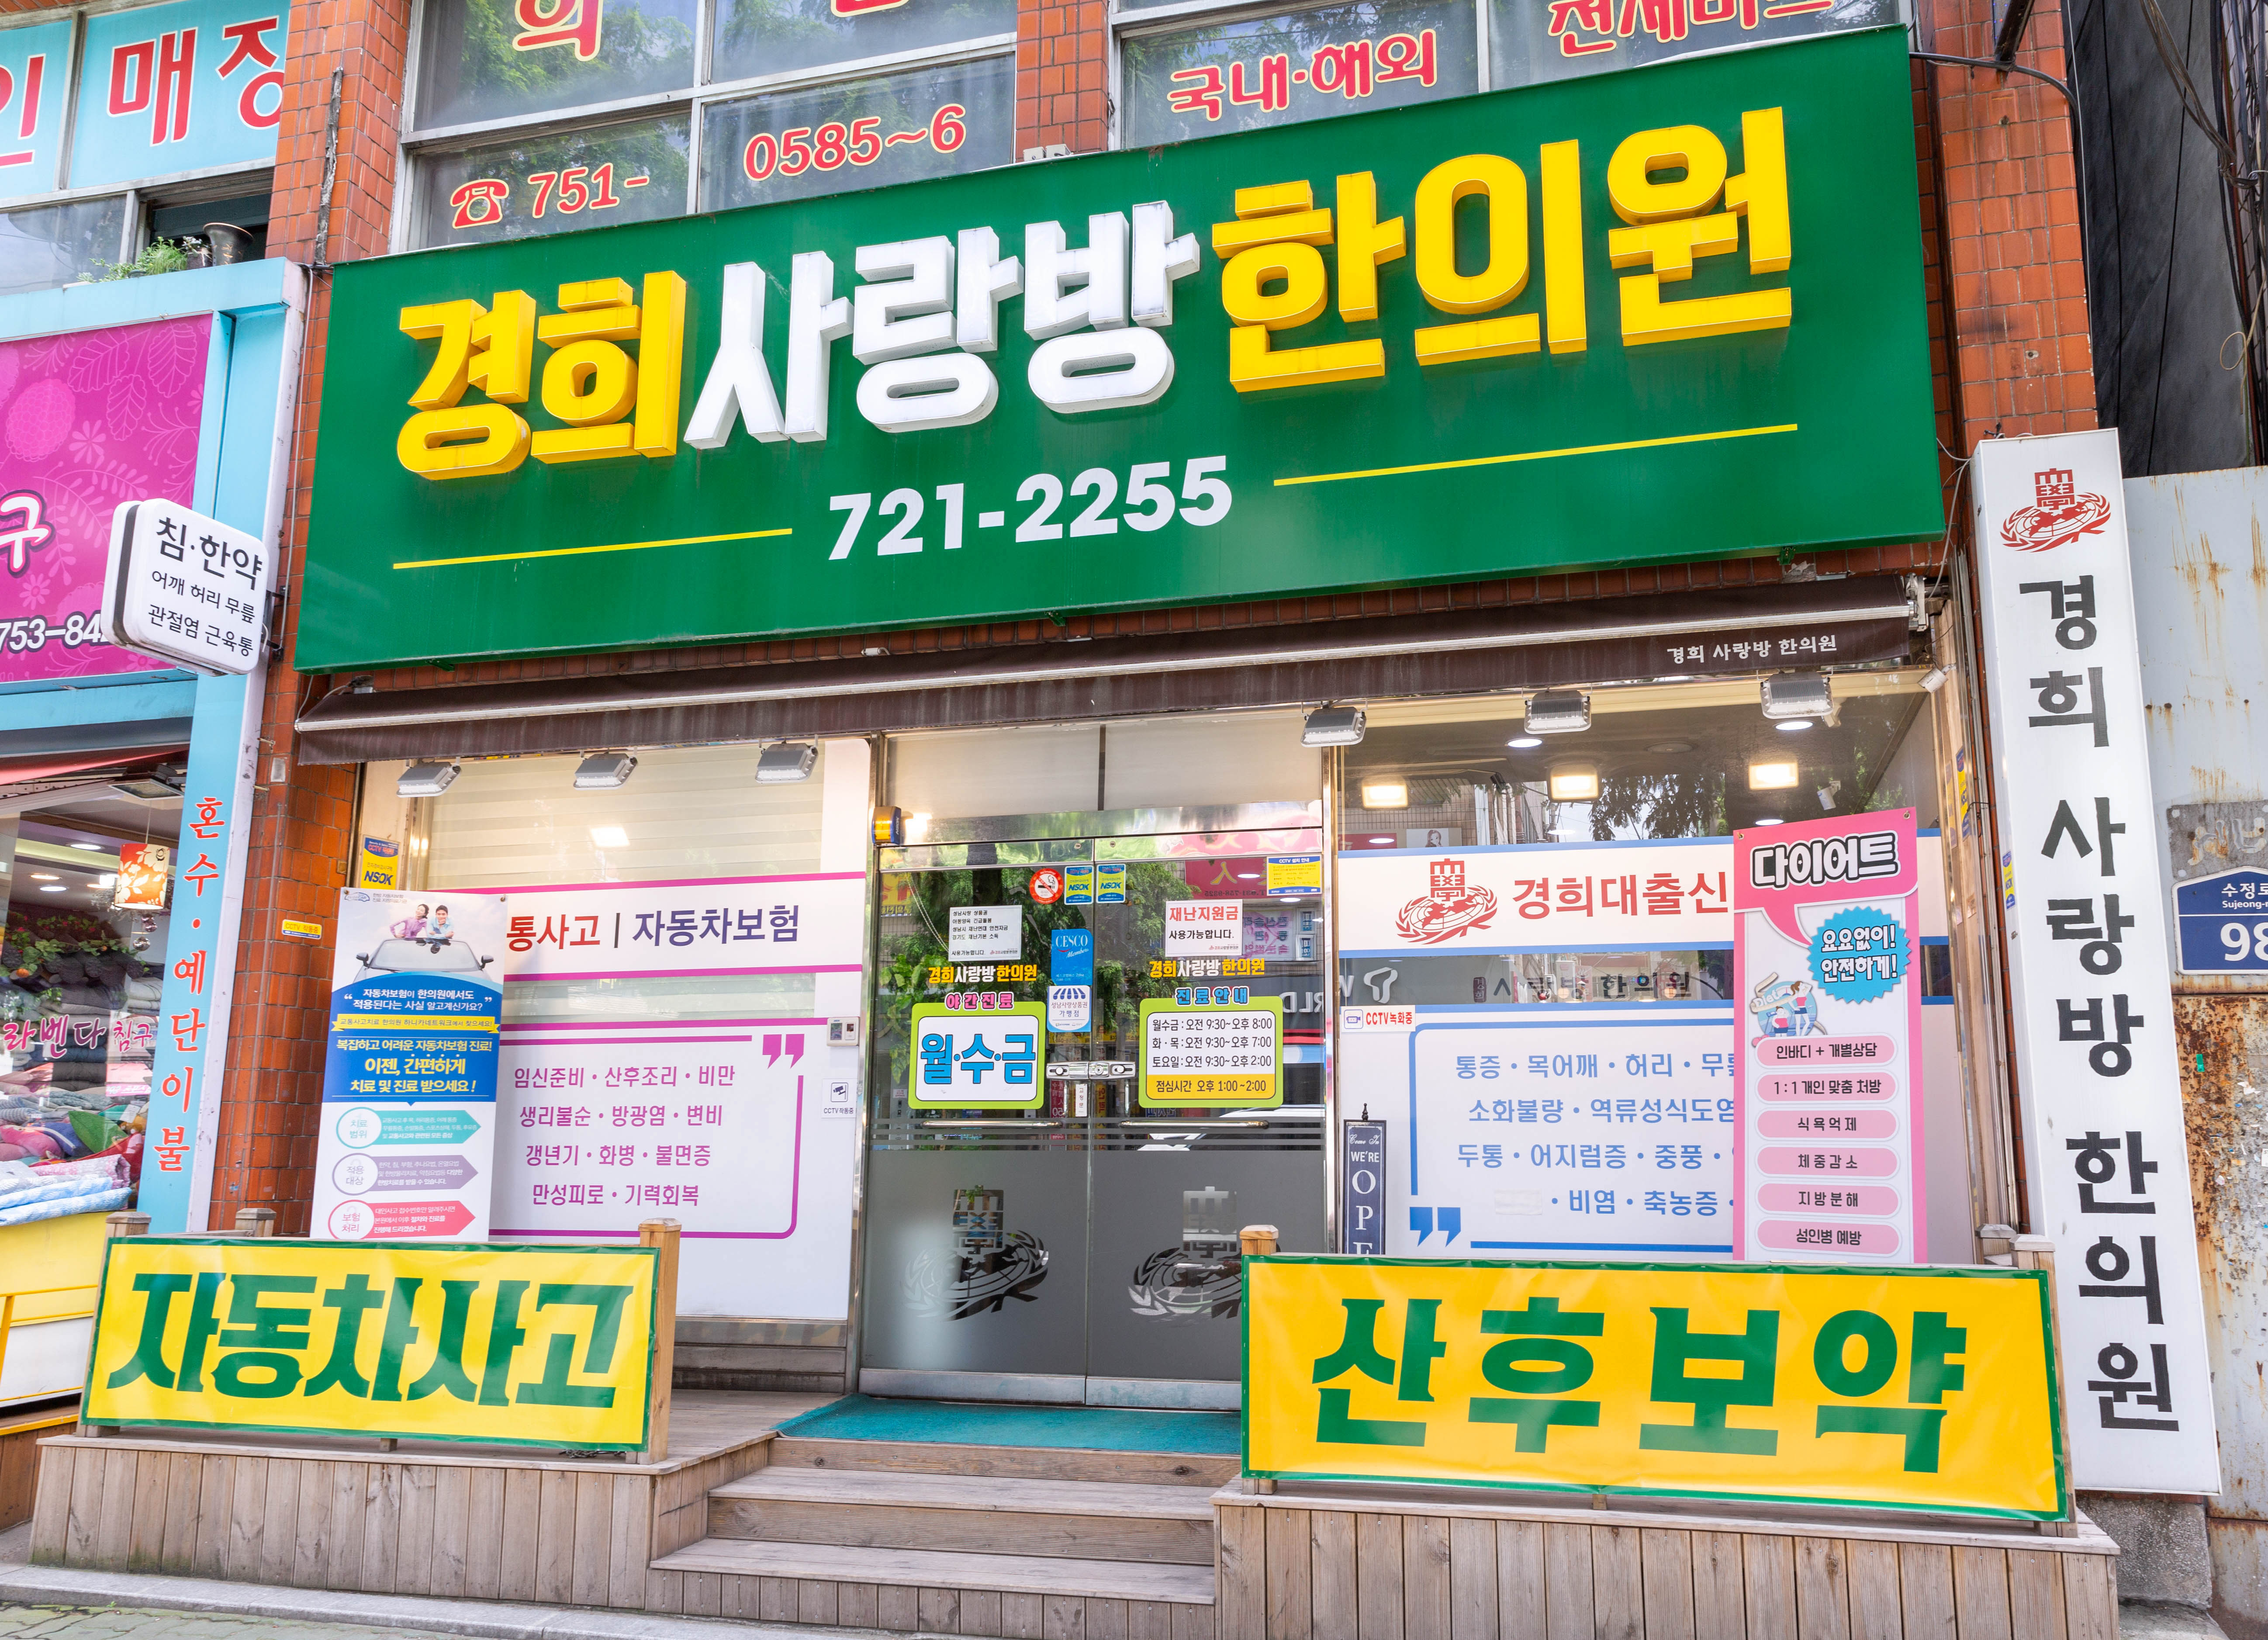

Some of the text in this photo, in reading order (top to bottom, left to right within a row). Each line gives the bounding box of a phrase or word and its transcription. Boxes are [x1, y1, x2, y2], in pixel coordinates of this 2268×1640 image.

[1166, 28, 1438, 121] 국내·해외
[527, 103, 967, 219] 751- 0585~6
[828, 454, 1232, 560] 721-2255
[152, 571, 255, 624] 어깨 허리 무릎
[0, 613, 109, 650] 753-84
[149, 604, 253, 657] 관절염 근육통
[1667, 635, 1837, 664] 경희 사랑방 한의원
[1751, 832, 1899, 888] 다이어트
[364, 871, 394, 885] NSOK
[1513, 872, 1728, 920] 경희대출신
[1169, 906, 1238, 921] 재난지원금
[286, 923, 301, 931] CCTV
[507, 904, 799, 951] 통사고 자동차보험
[1169, 930, 1234, 940] 사용가능합니다.
[1056, 934, 1088, 947] CESCO
[1821, 924, 1896, 952] 요요없이!
[1066, 947, 1089, 958] Members
[1821, 954, 1897, 983] 안전하게!
[363, 989, 474, 999] 자동차보험이 한의원에서도
[946, 993, 1014, 1010] 야간진료
[1176, 986, 1248, 1005] 진료안내
[2019, 574, 2179, 1431] 경희 사랑방 한의원
[353, 1000, 483, 1011] 적용된다는 사실 알고계신가요?
[1186, 1019, 1203, 1031] 오전
[1252, 1018, 1272, 1029] 8:00
[3, 1014, 106, 1059] 라벤다
[1185, 1037, 1202, 1048] 오전
[1252, 1036, 1272, 1047] 7:00
[336, 1040, 492, 1052] 복잡하고 어려운 자동차보험 진료!
[1777, 1043, 1877, 1059] 인바디 개별상담
[365, 1058, 466, 1076] 이젠, 간편하게
[1185, 1056, 1202, 1068] 오전
[1251, 1055, 1272, 1066] 2:00
[1456, 1055, 1500, 1079] 통증
[1528, 1054, 1598, 1078] 목어깨
[1625, 1053, 1672, 1077] 허리
[514, 1066, 735, 1088] 임신준비 산후조리 비만
[350, 1080, 376, 1092] 치료
[379, 1080, 391, 1093] 및
[394, 1080, 418, 1092] 진료
[1156, 1080, 1192, 1092] 점심시간
[1197, 1080, 1214, 1092] 오후
[1801, 1081, 1825, 1094] 개인
[1829, 1080, 1853, 1094] 맞춤
[1857, 1079, 1881, 1093] 처방
[520, 1104, 723, 1127] 생리불순 방광염 변비
[1469, 1098, 1734, 1123] 소화불량 역류성식도염
[350, 1119, 367, 1128] 치료
[1798, 1117, 1857, 1131] 식욕억제
[350, 1130, 367, 1138] 범위
[1349, 1134, 1366, 1145] Come
[526, 1145, 711, 1166] 갱년기 화병 불면증
[1458, 1144, 1702, 1169] 두통 어지럼증 중풍
[1798, 1154, 1858, 1169] 체중감소
[346, 1166, 364, 1175] 적용
[346, 1176, 363, 1185] 대상
[532, 1184, 699, 1207] 만성피로 기력회복
[1569, 1190, 1718, 1215] 비염 축농증
[1799, 1191, 1858, 1207] 지방분해
[342, 1212, 360, 1221] 보험
[342, 1223, 359, 1232] 처리
[1796, 1228, 1861, 1246] 성인병 예방
[107, 1272, 633, 1408] 자동차사고
[1313, 1296, 1967, 1473] 산후보약
